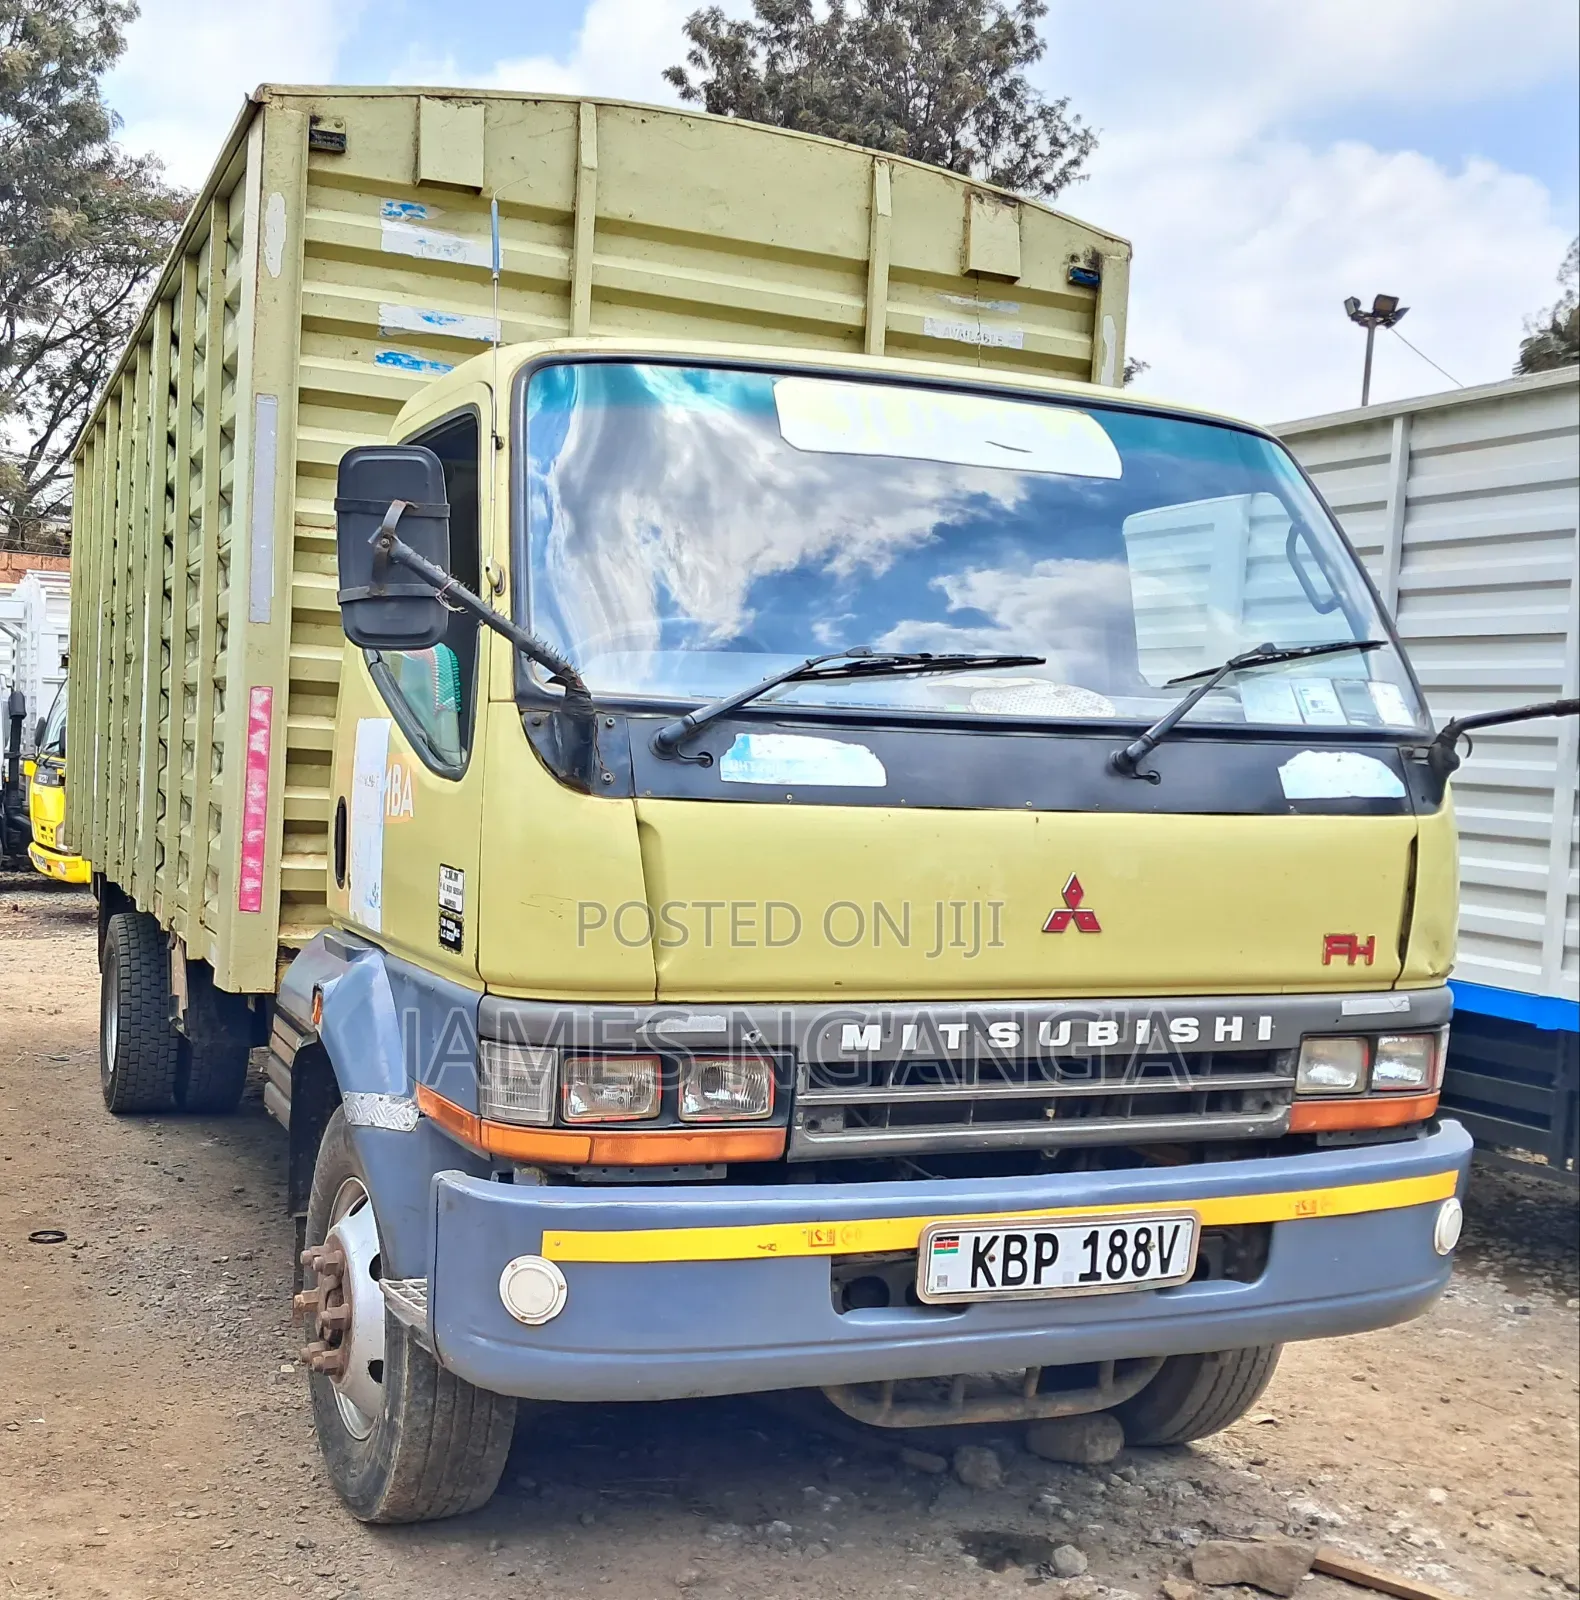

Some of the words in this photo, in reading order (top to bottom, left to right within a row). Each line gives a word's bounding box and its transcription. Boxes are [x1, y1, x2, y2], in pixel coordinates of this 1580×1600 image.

[1322, 933, 1376, 966] FH
[841, 1015, 1275, 1052] MITSUBISHI
[970, 1232, 1060, 1288] KBP
[1078, 1224, 1181, 1283] 188V
